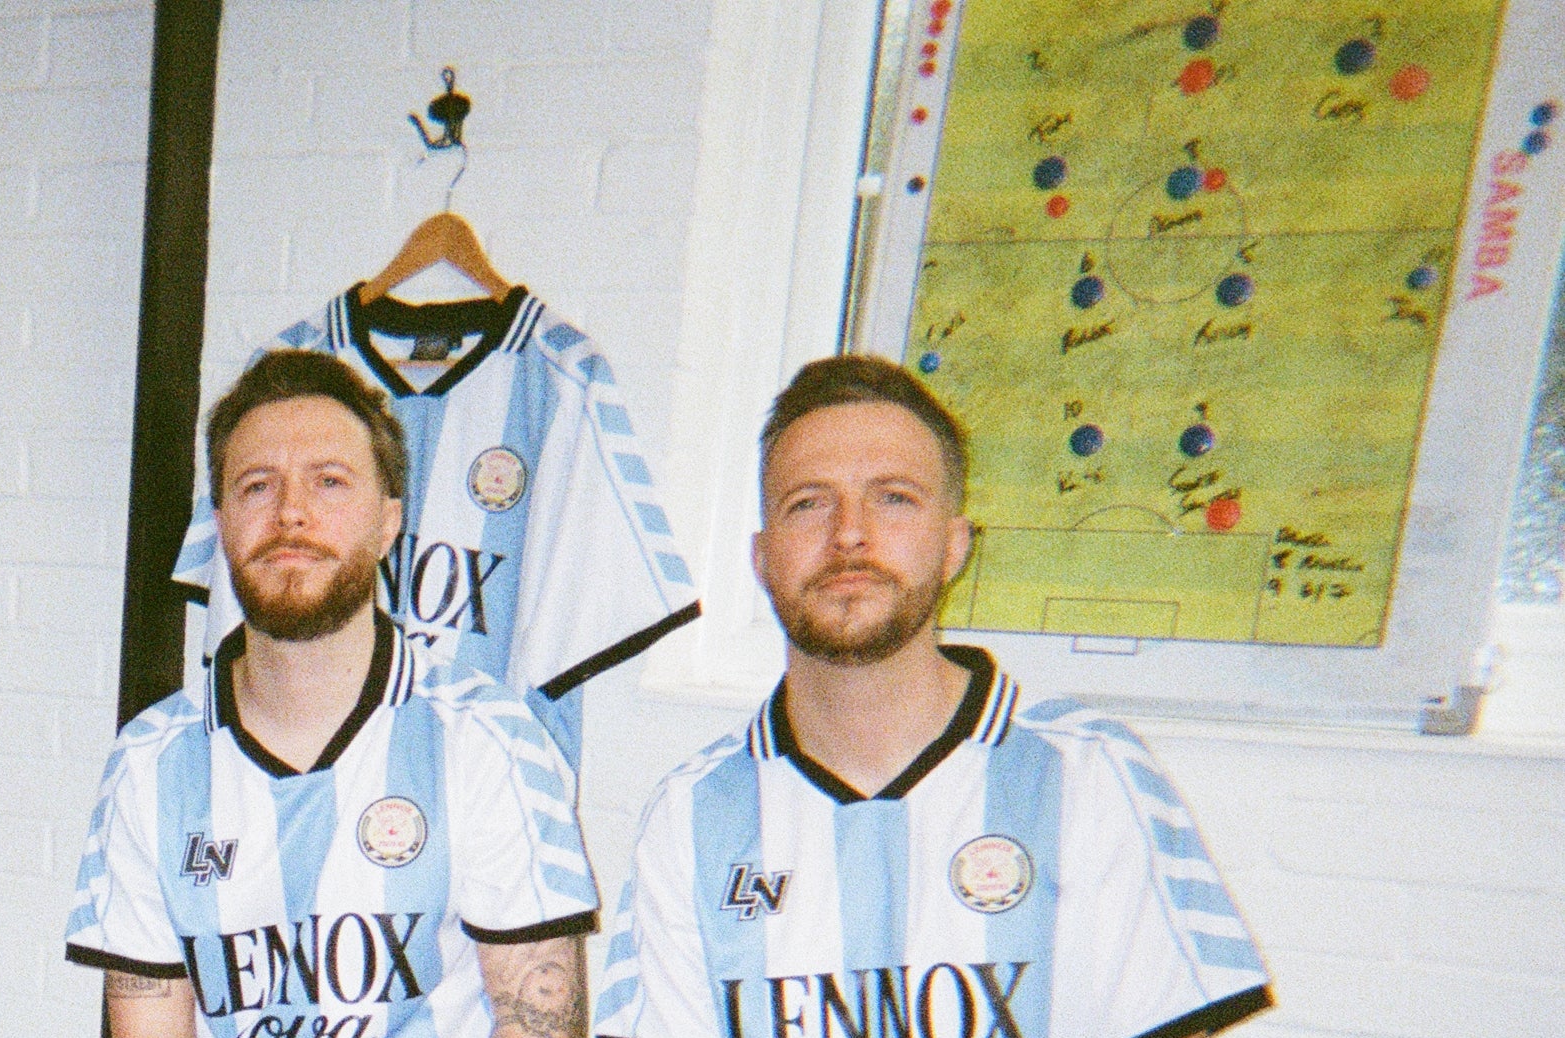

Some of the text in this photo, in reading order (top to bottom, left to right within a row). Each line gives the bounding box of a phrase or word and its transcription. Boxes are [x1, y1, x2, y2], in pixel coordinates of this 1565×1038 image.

[1466, 151, 1528, 300] SAMBA
[180, 832, 238, 887] LN
[720, 863, 794, 922] LN
